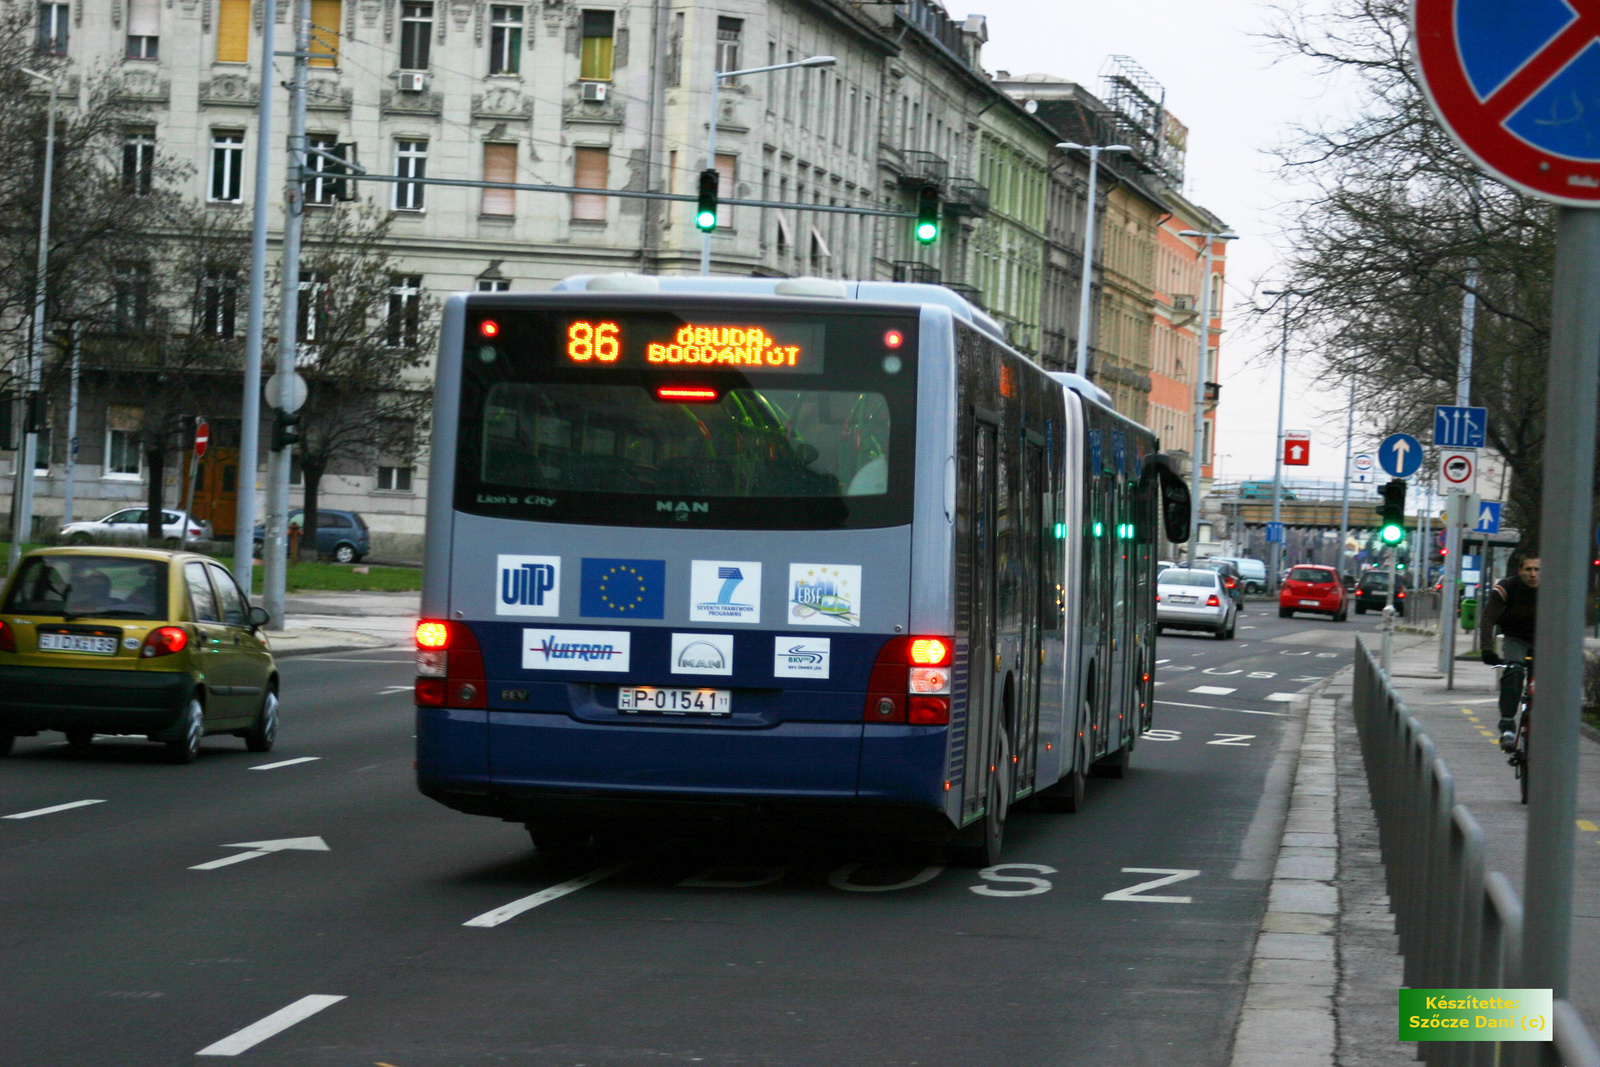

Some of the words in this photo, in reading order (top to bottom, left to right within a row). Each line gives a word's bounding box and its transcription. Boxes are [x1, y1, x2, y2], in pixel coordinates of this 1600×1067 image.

[568, 322, 619, 361] 86
[676, 324, 773, 347] ÓBUDA,
[476, 494, 518, 504] Lion's
[524, 494, 556, 507] City
[656, 501, 709, 512] MAN
[502, 563, 555, 606] UITP
[541, 635, 614, 662] VULTRON
[682, 659, 722, 669] MAN
[622, 698, 631, 707] H
[634, 690, 716, 710] P-01541
